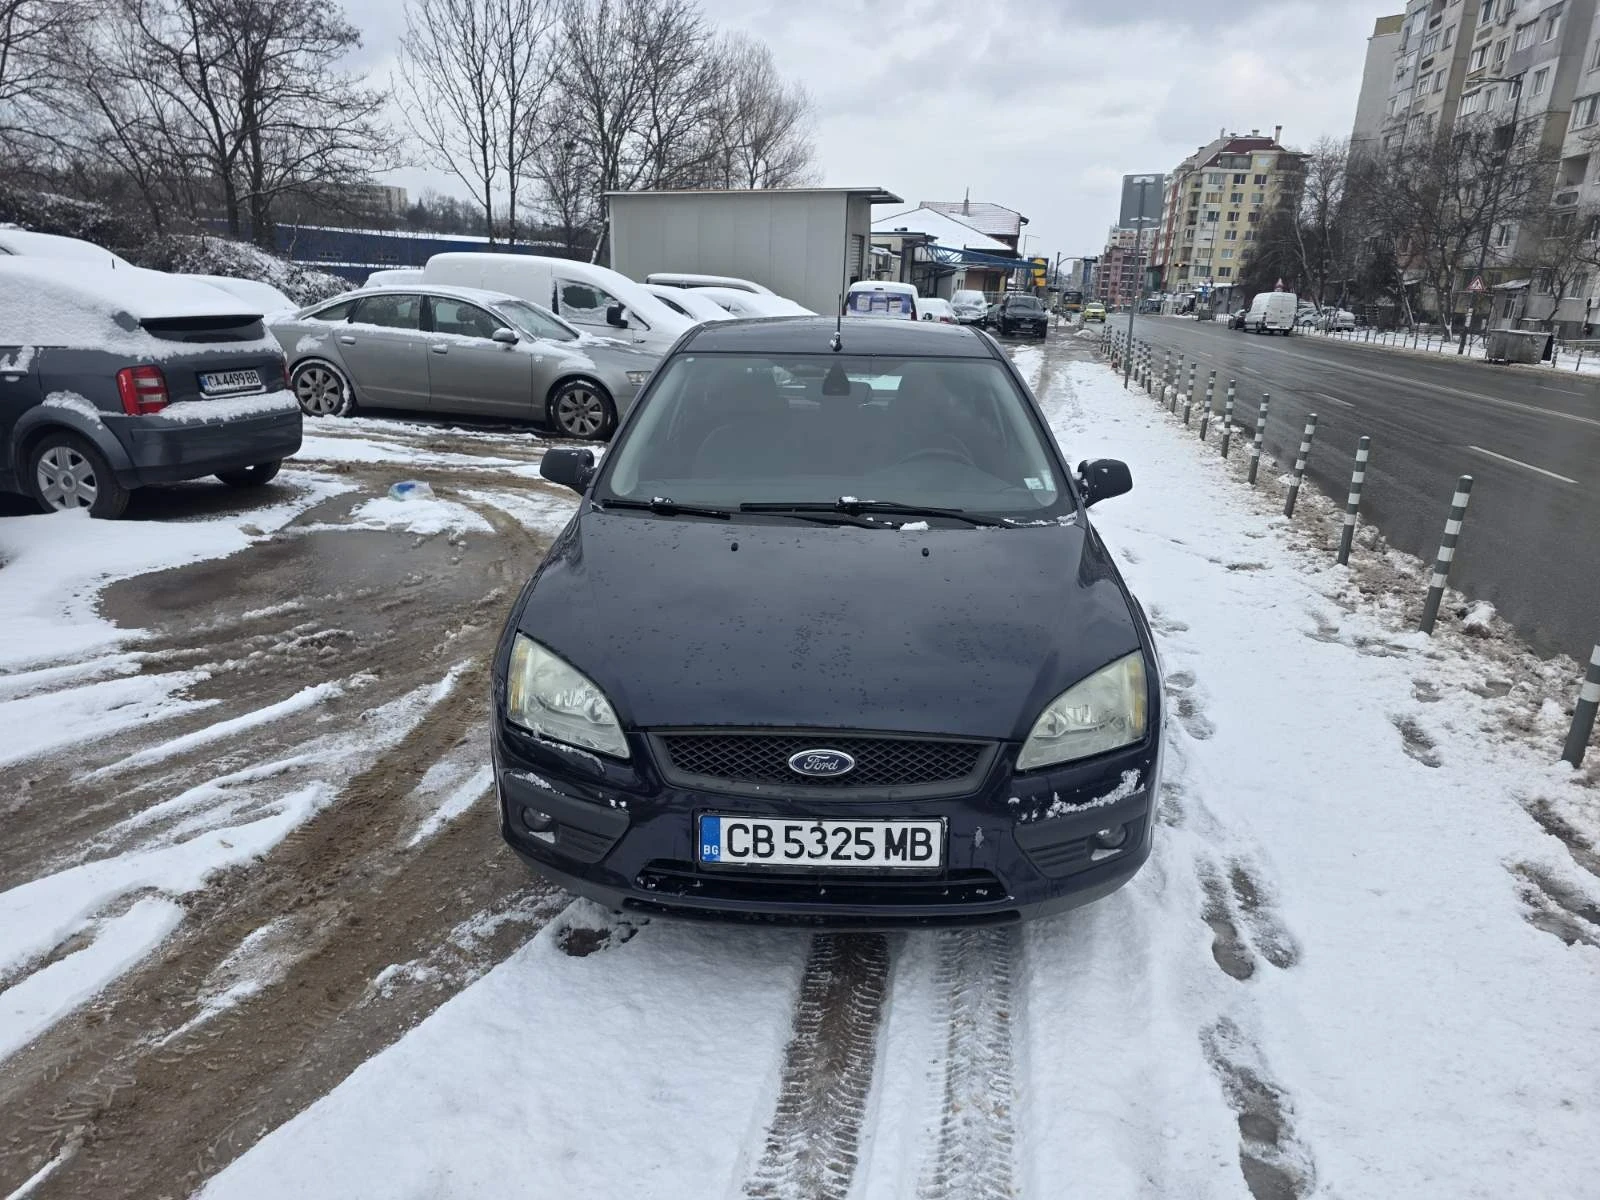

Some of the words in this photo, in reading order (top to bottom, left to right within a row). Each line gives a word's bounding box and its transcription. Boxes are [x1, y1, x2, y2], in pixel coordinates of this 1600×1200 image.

[803, 754, 839, 770] Ford
[727, 823, 775, 858] CB
[784, 825, 876, 861] 5325
[884, 827, 933, 861] MB
[703, 845, 719, 856] BG
